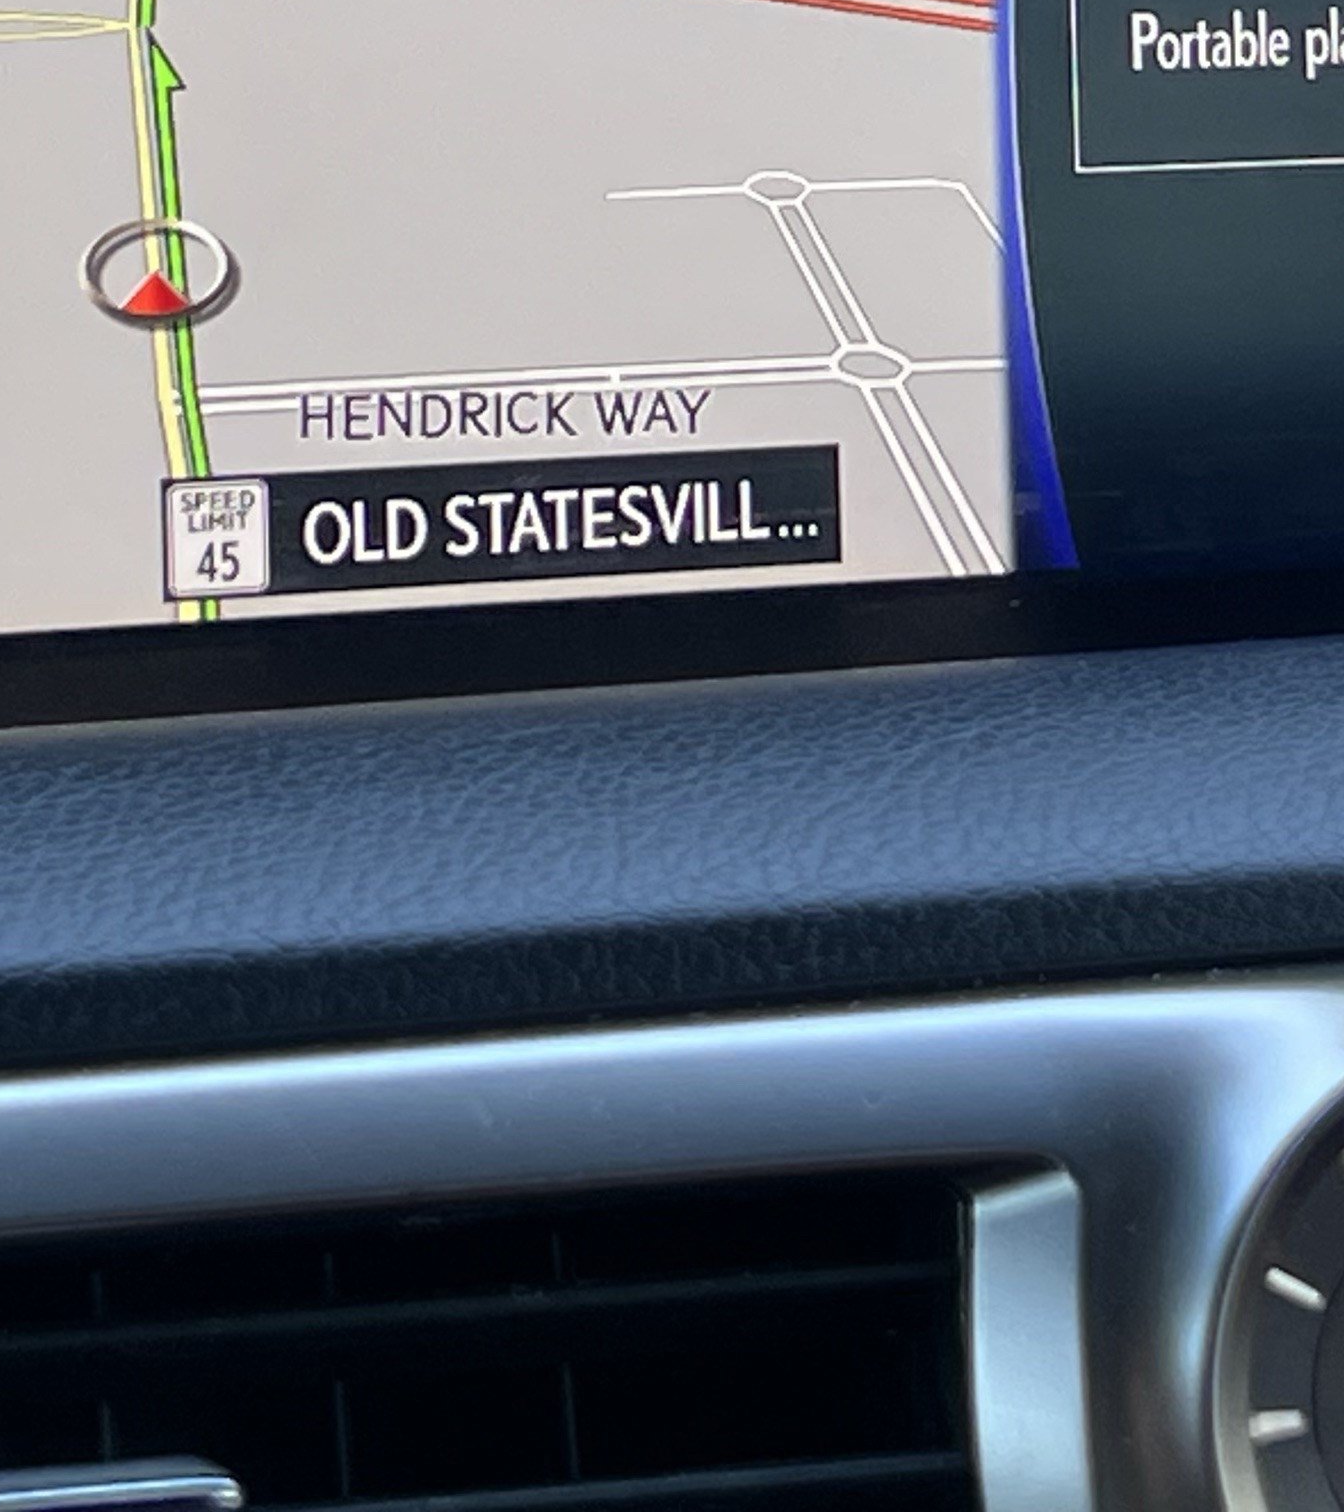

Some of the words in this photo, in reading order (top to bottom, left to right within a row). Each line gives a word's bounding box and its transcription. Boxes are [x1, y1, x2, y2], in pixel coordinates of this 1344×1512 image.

[1130, 9, 1291, 71] Portable
[299, 392, 575, 440] HENDRICK
[594, 389, 712, 437] WAY
[180, 490, 256, 514] SPEED
[188, 511, 249, 533] LIMIT
[302, 499, 429, 565] OLD
[196, 542, 241, 582] 45
